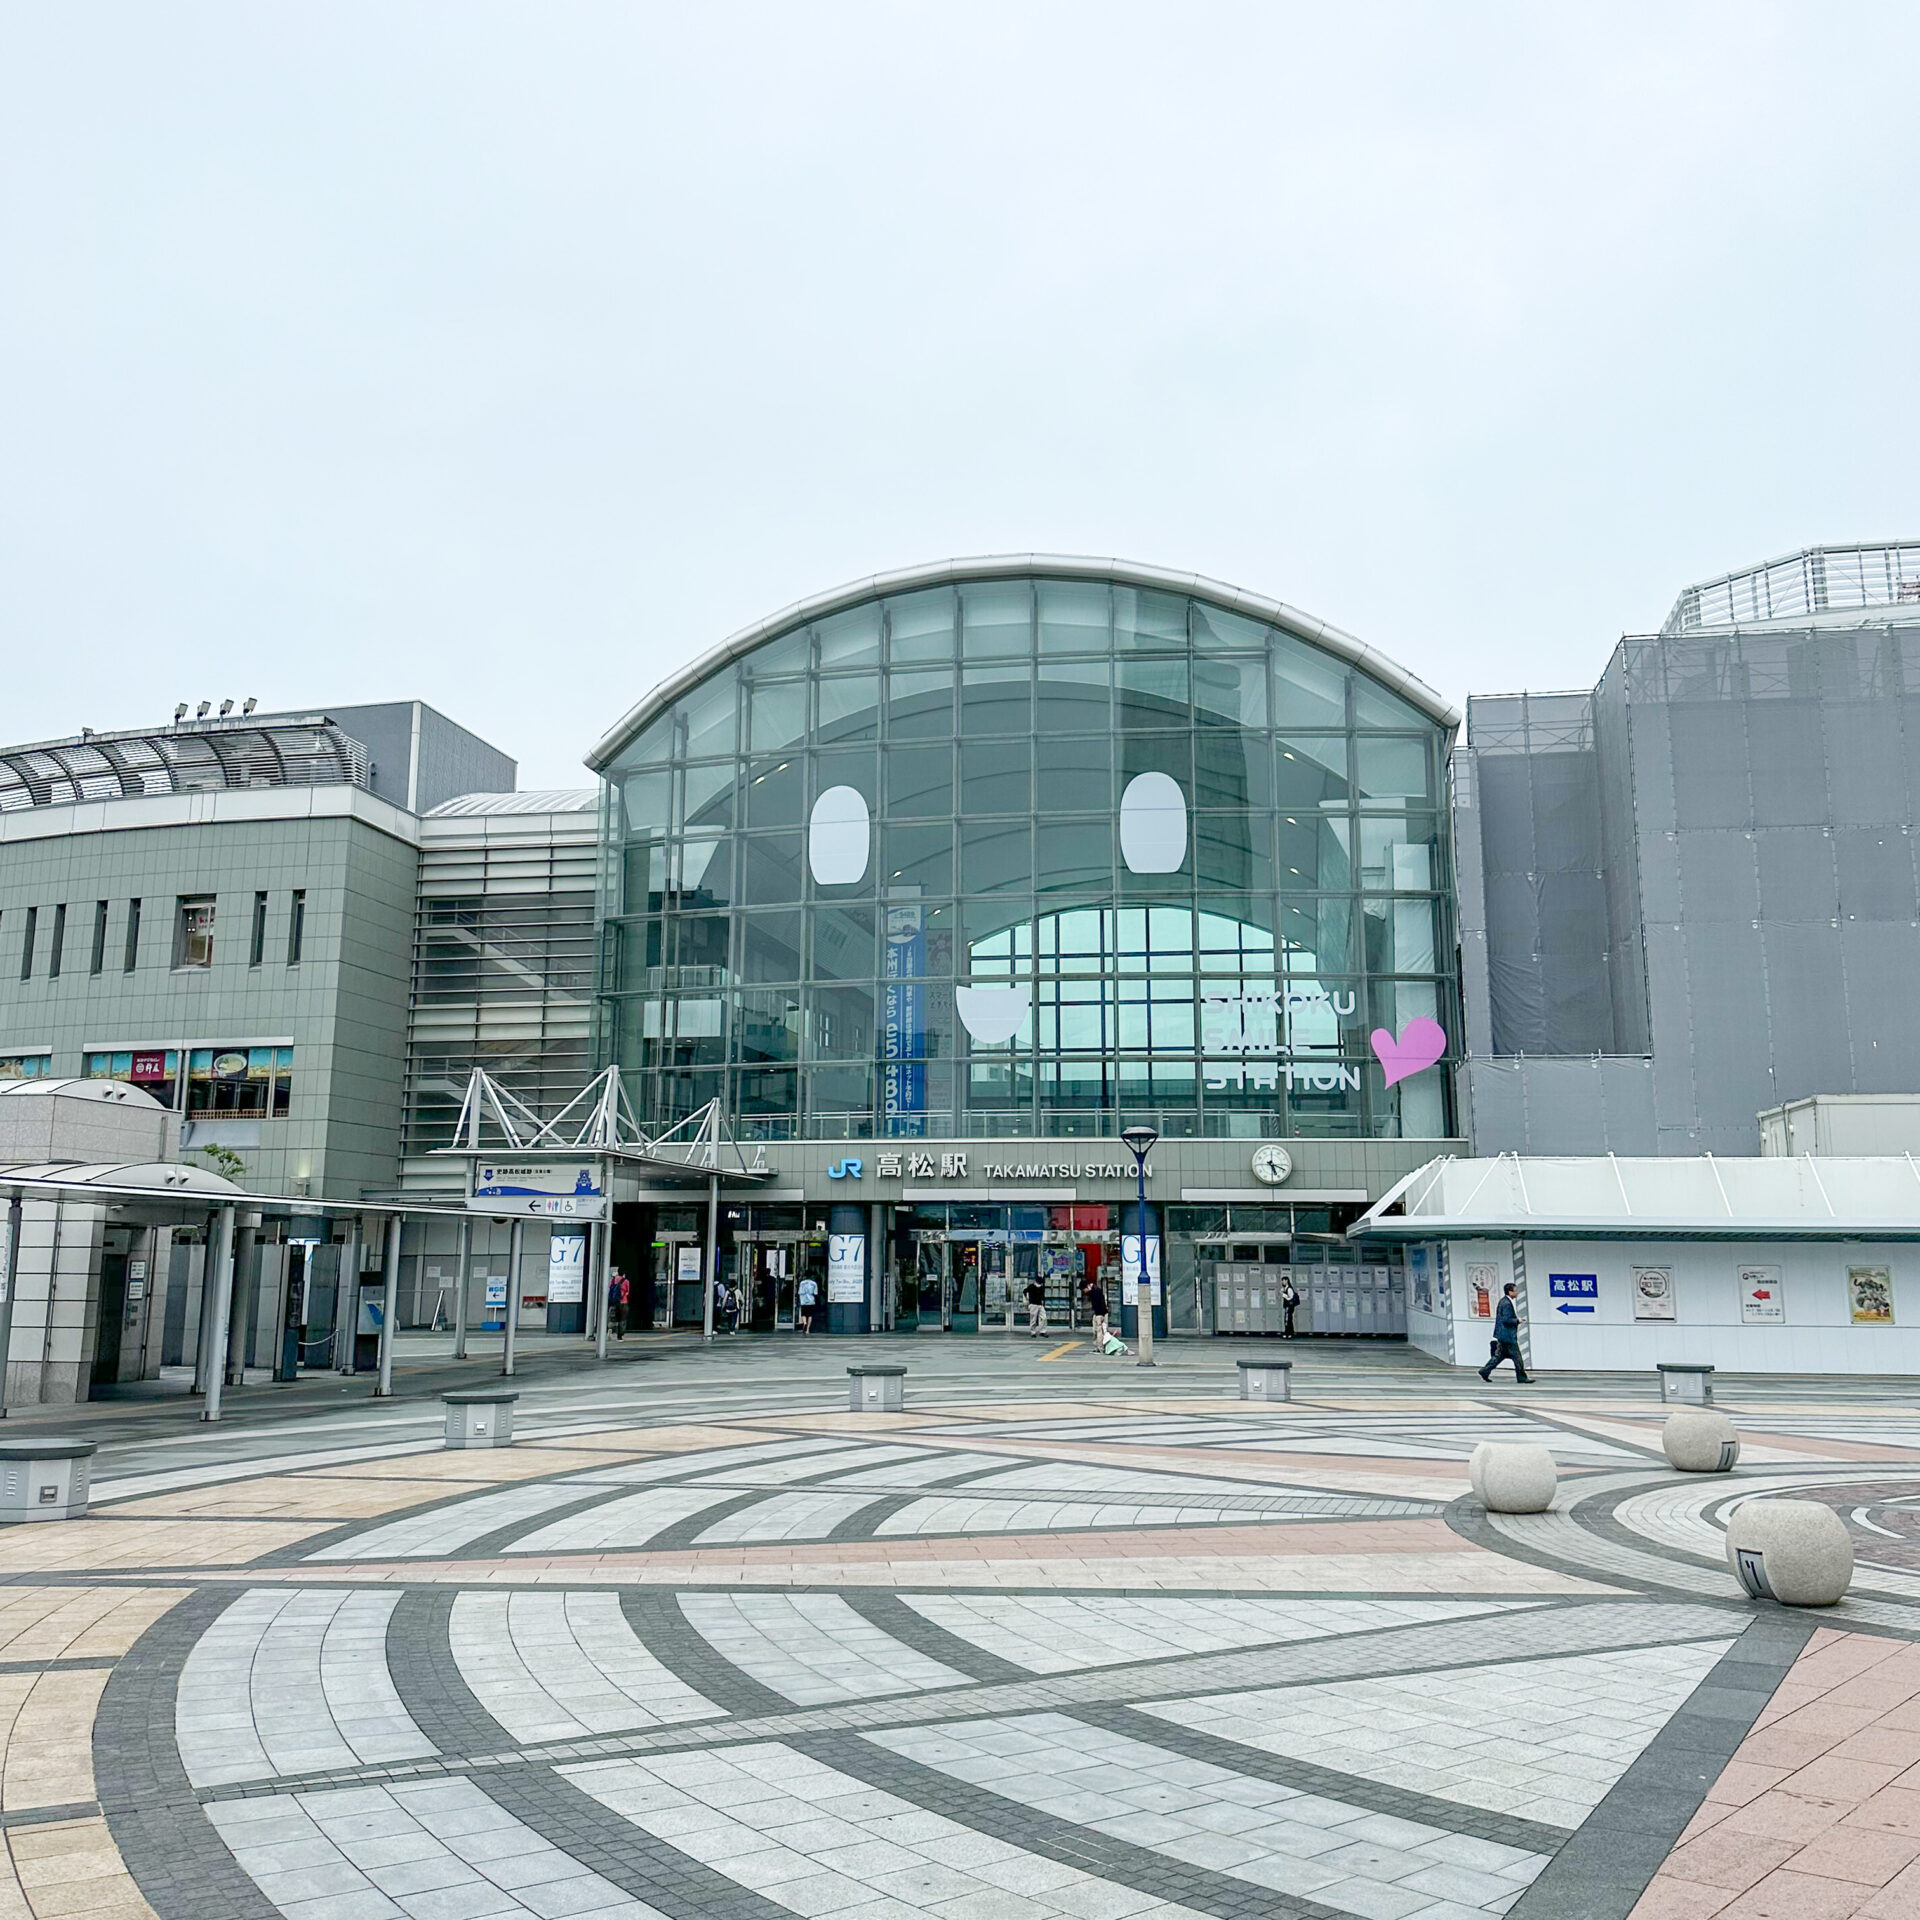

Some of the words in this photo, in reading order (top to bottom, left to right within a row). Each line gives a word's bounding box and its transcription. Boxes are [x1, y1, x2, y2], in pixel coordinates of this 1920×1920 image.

[1204, 991, 1355, 1014] SHIKOKU
[1204, 1028, 1311, 1051] SMILE
[1206, 1066, 1361, 1091] STATION
[828, 1158, 863, 1180] JR
[876, 1152, 968, 1178] 高松駅
[984, 1163, 1081, 1178] TAKAMATSU
[1085, 1163, 1154, 1178] STATION
[551, 1234, 586, 1264] G7
[829, 1233, 865, 1263] G7
[1122, 1235, 1160, 1264] G7
[1553, 1279, 1595, 1292] 高松駅
